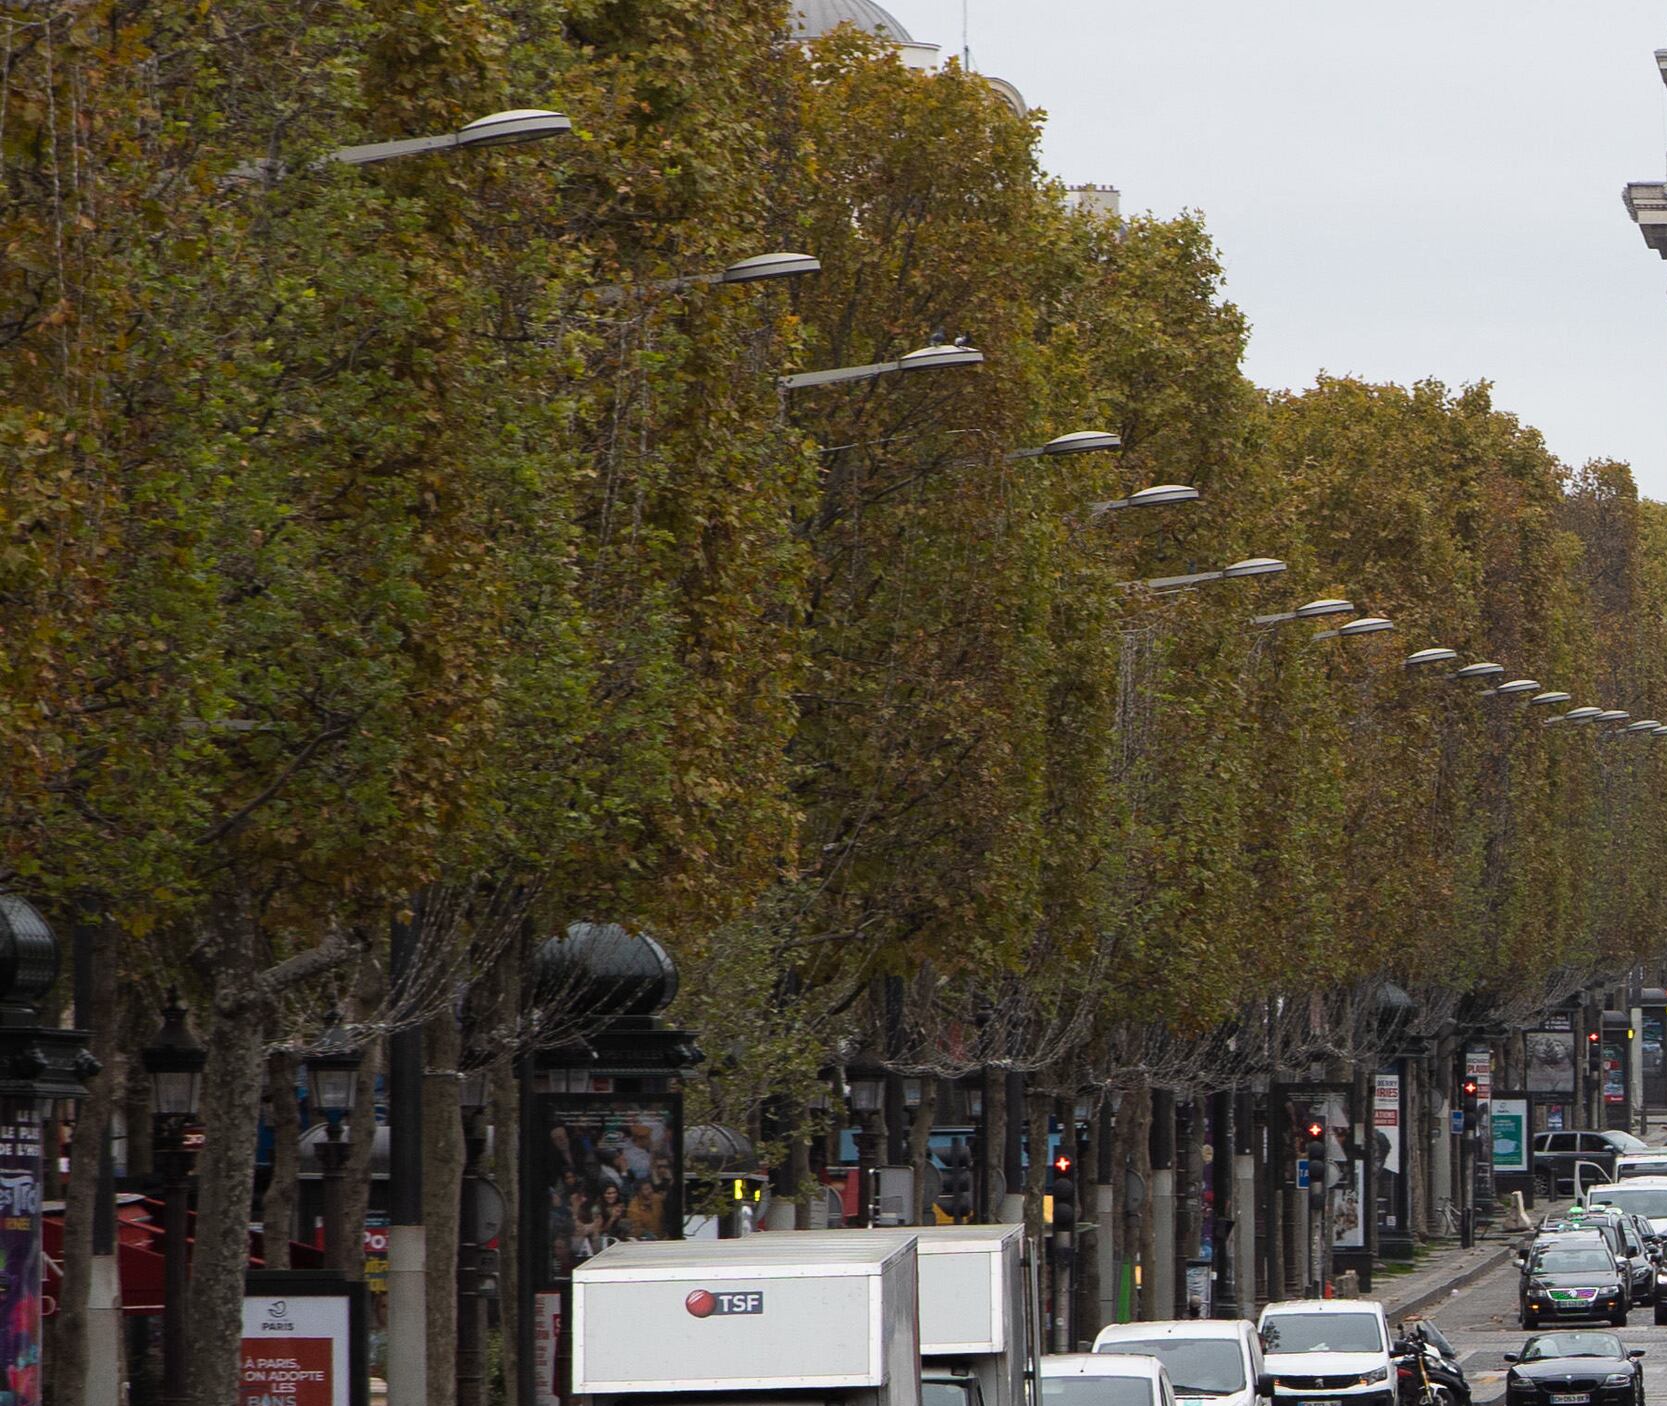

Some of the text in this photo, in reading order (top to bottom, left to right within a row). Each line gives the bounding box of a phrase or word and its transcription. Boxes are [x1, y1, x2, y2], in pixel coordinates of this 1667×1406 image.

[719, 1295, 759, 1312] TSF
[261, 1322, 294, 1331] PARIS
[244, 1357, 301, 1370] À PARIS,
[244, 1371, 325, 1381] ON ADOPTE
[272, 1383, 297, 1393] LES
